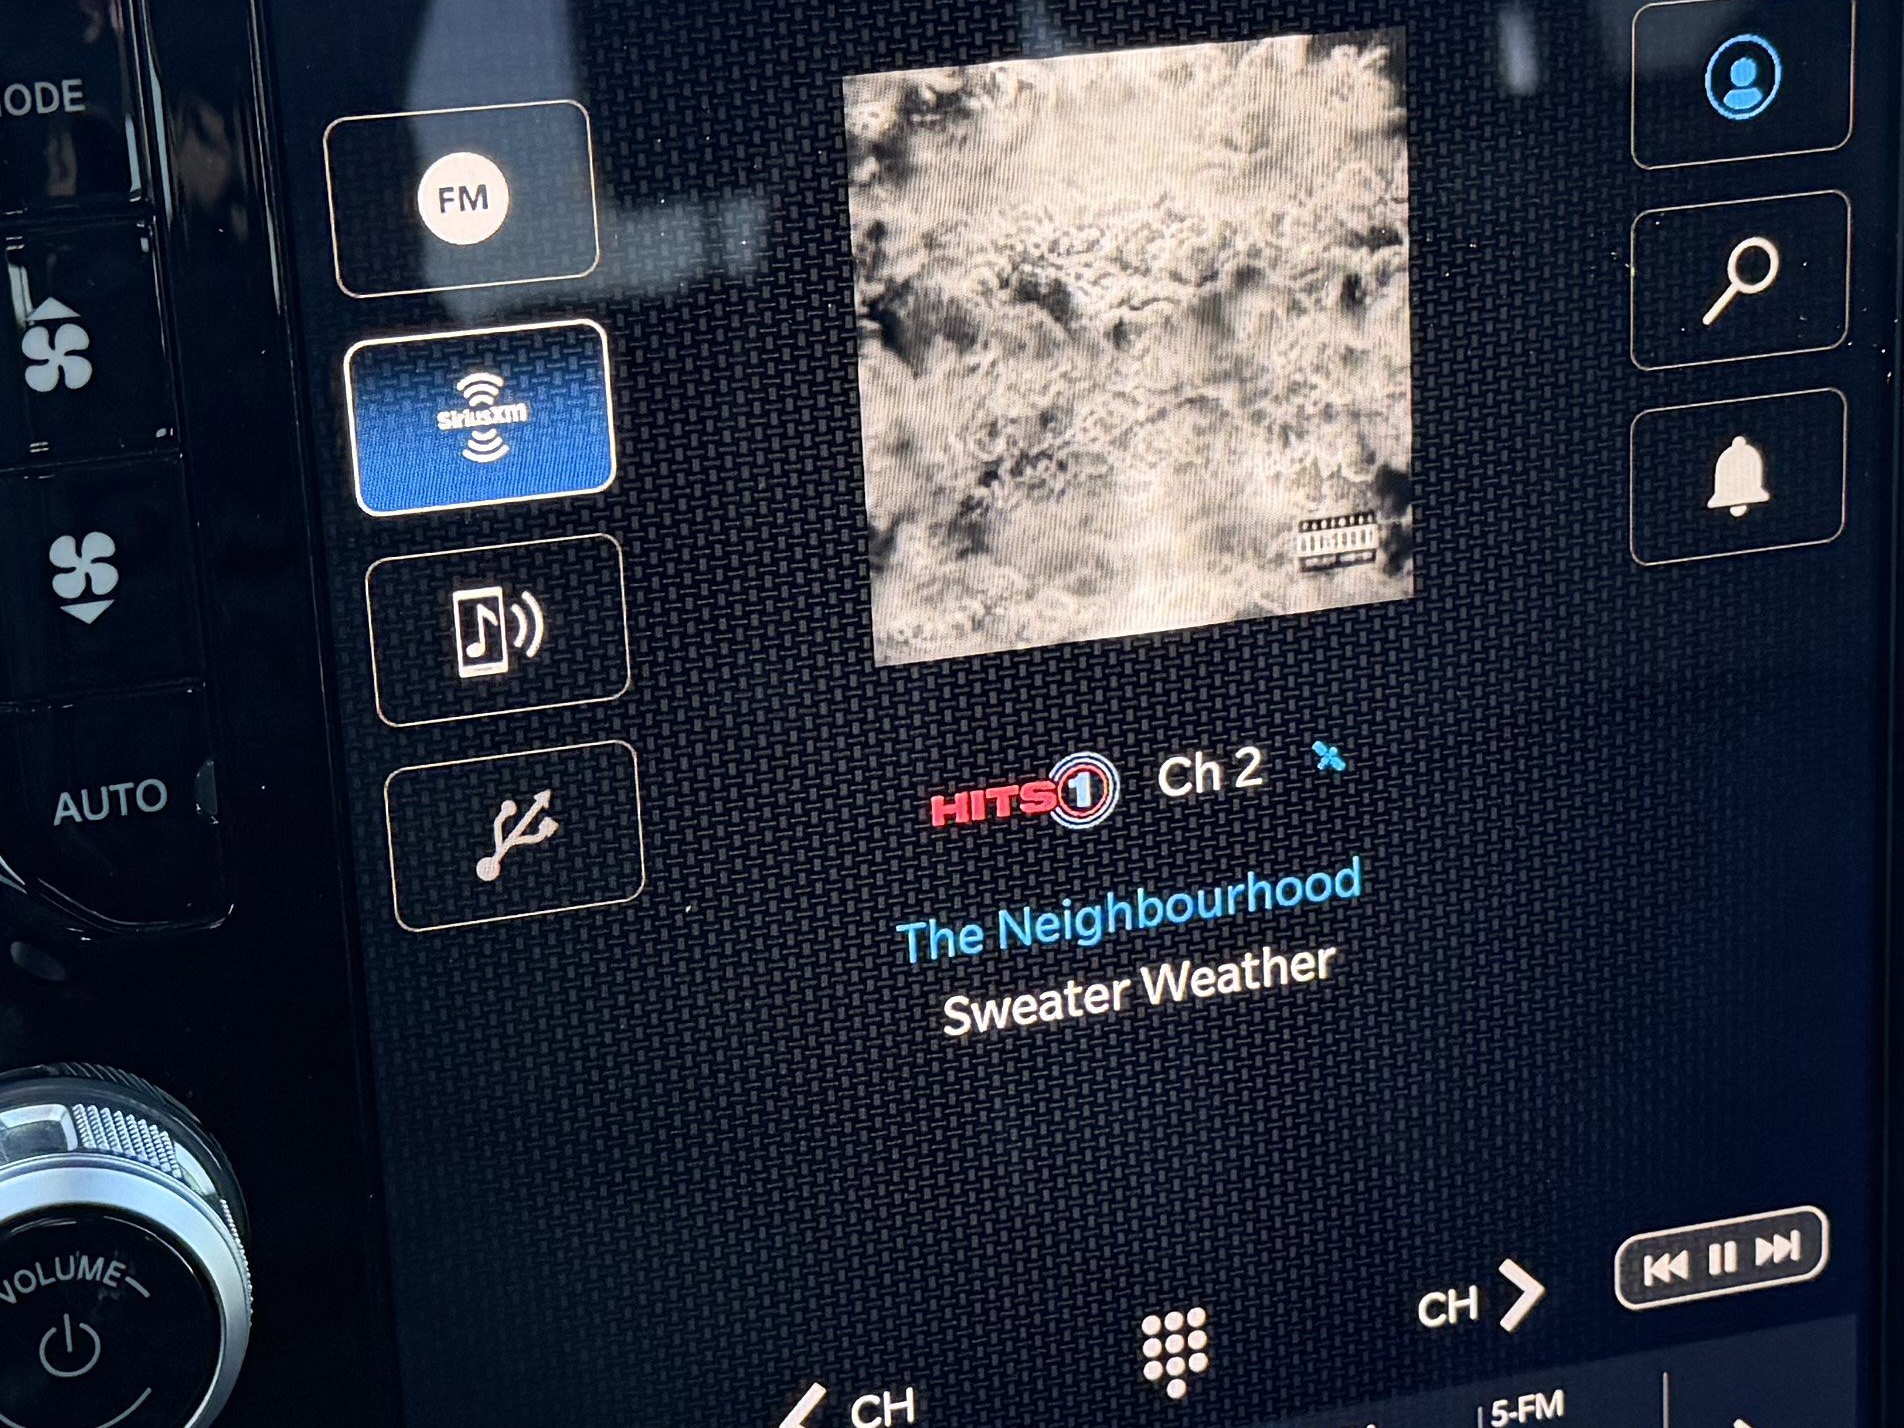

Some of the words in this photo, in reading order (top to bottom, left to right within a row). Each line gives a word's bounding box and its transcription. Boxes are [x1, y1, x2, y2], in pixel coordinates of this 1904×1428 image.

[436, 183, 490, 214] FM
[1158, 750, 1224, 798] Ch
[1234, 745, 1265, 788] 2
[52, 779, 168, 826] AUTO
[896, 918, 985, 965] The
[998, 856, 1363, 951] Neighbourhood
[943, 975, 1131, 1037] Sweater
[1140, 941, 1337, 1006] Weather
[1417, 1284, 1479, 1329] CH
[1490, 1389, 1565, 1428] 5-FM
